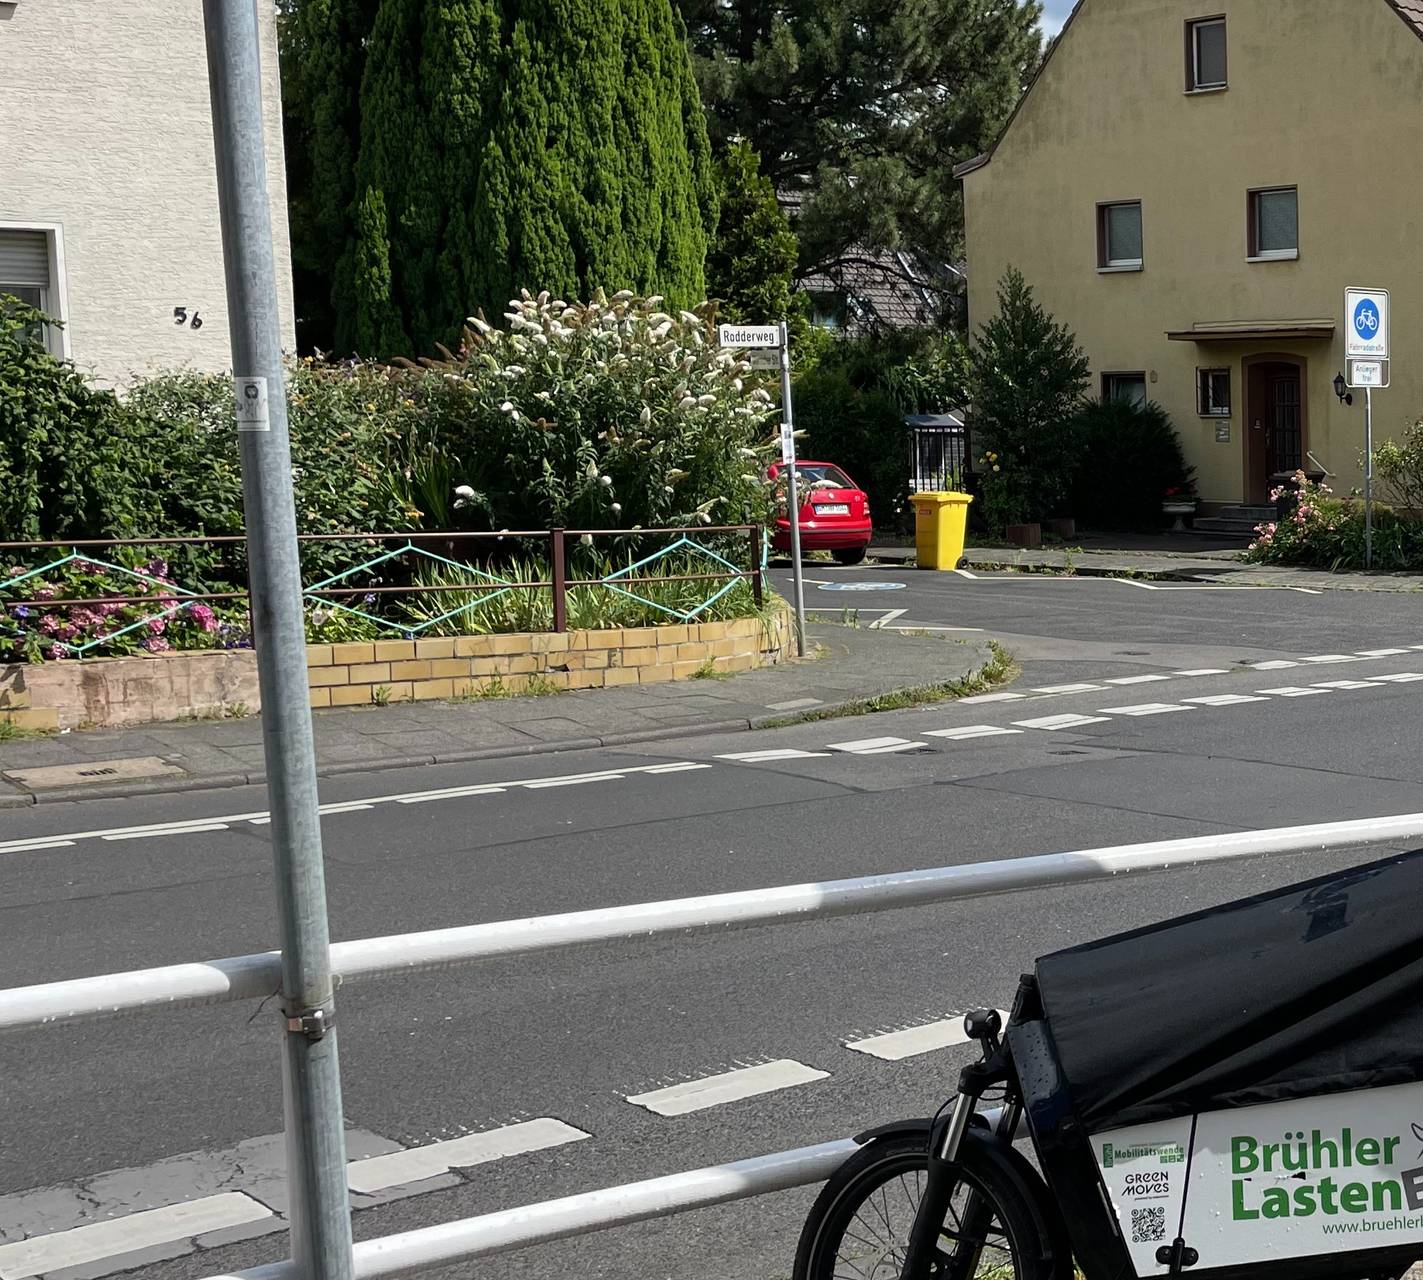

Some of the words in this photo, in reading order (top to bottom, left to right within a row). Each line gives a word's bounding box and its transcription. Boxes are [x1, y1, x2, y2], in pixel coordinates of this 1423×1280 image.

[173, 306, 203, 330] 56
[723, 330, 775, 345] Rodderweg
[1114, 1145, 1184, 1160] Mobilitätswende
[1231, 1127, 1400, 1174] Brühler
